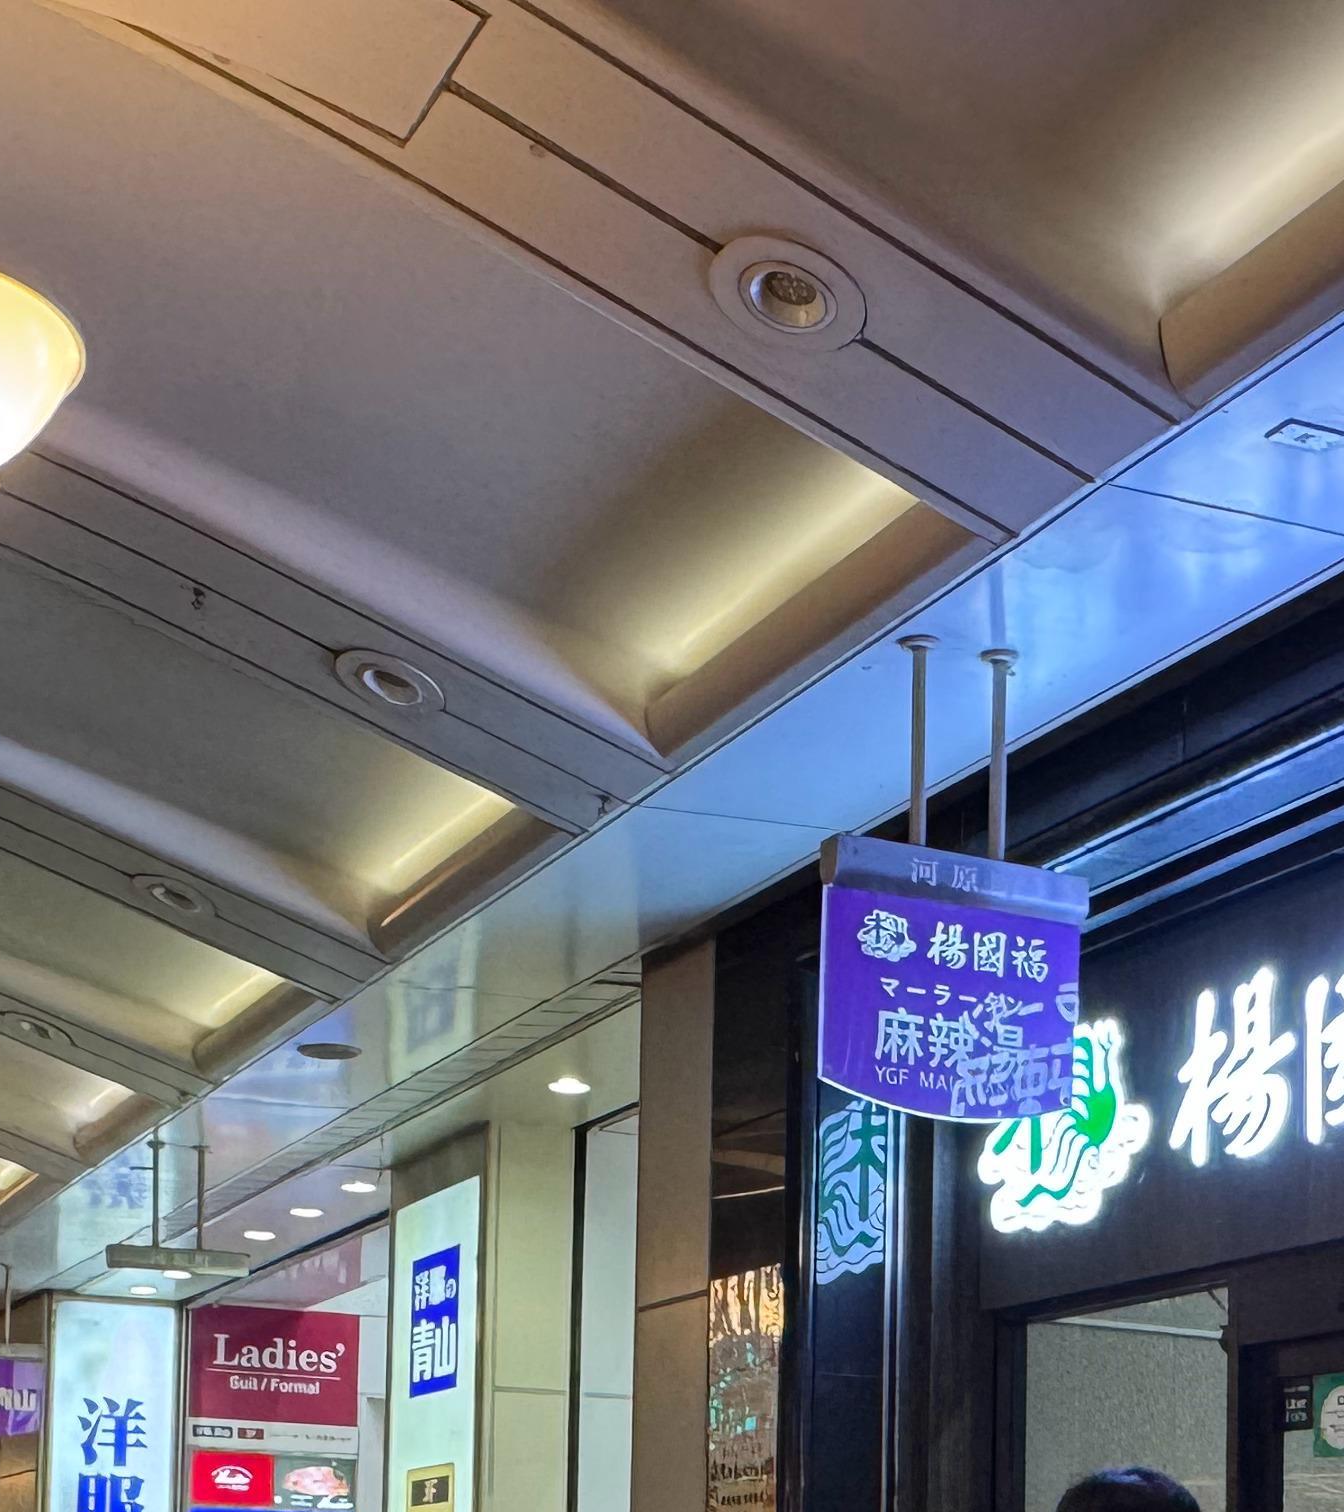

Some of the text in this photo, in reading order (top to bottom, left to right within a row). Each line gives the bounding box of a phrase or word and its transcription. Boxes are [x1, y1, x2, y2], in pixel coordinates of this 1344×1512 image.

[926, 921, 1049, 983] 楊國福
[875, 1065, 910, 1087] YGF
[213, 1333, 346, 1374] Ladies'
[412, 1316, 456, 1384] 青山
[270, 1378, 320, 1395] Formal
